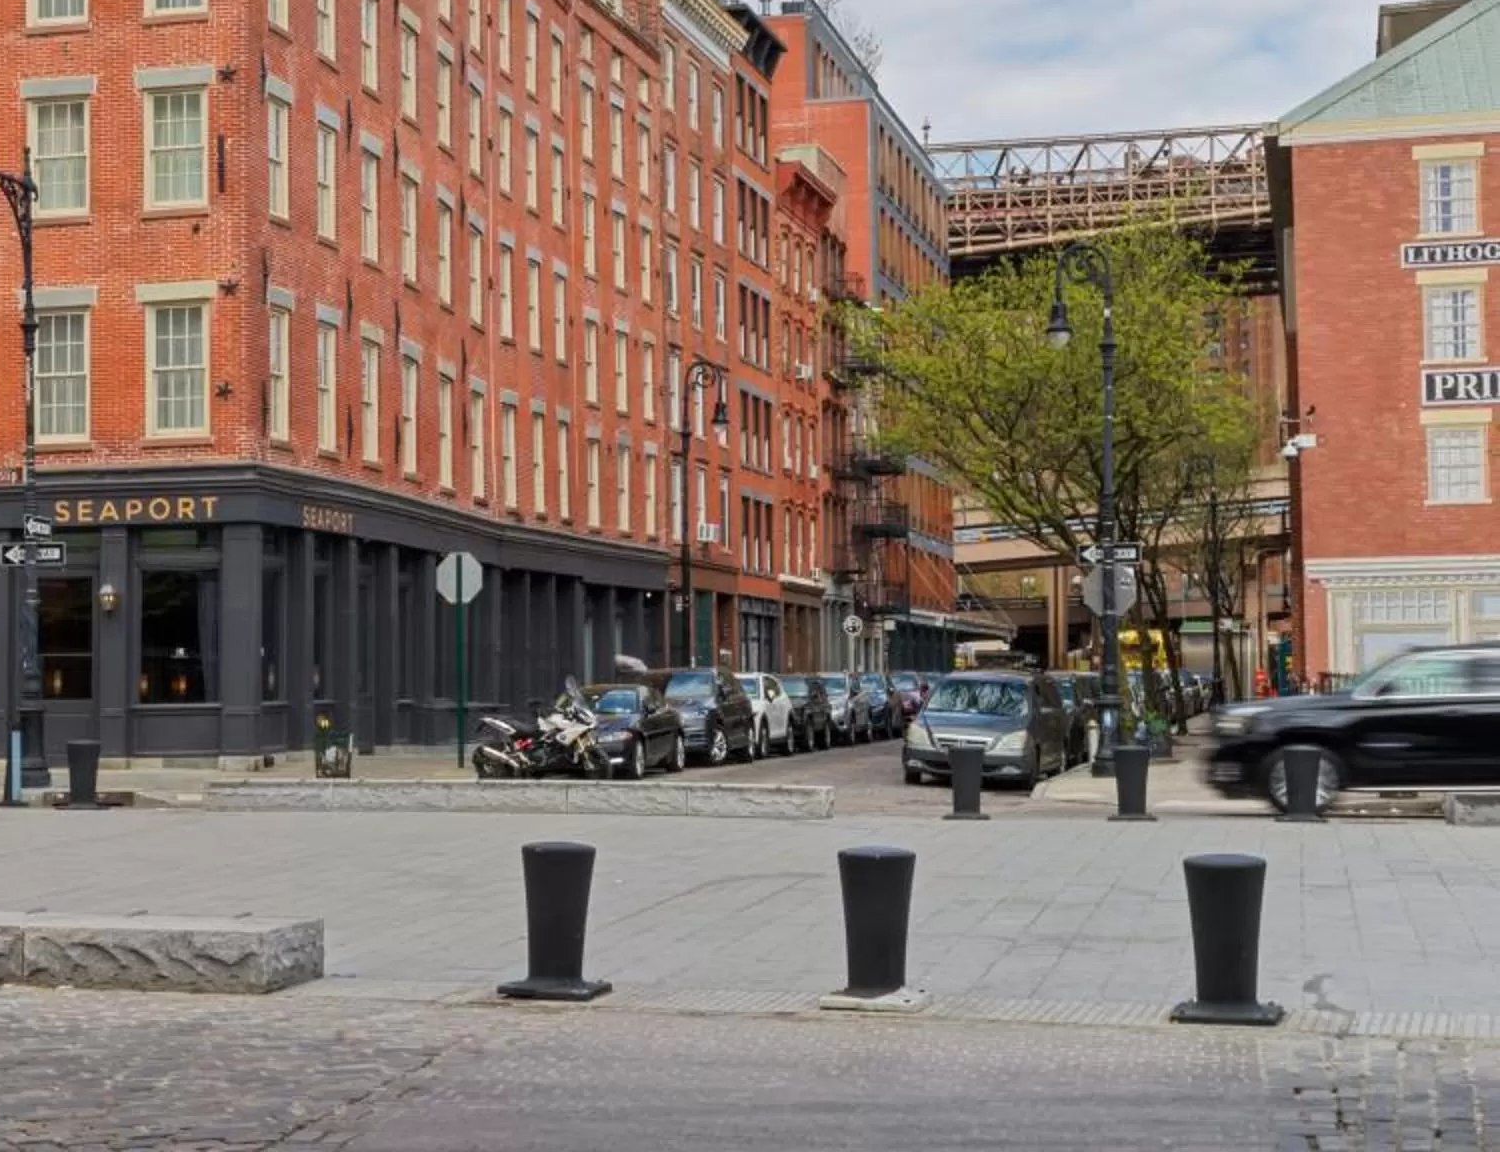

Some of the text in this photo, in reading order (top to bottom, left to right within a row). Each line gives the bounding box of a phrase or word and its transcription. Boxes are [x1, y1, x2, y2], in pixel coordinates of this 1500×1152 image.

[1434, 374, 1500, 400] PRI
[54, 497, 219, 523] SEAPORT
[303, 504, 356, 533] SEAPORT
